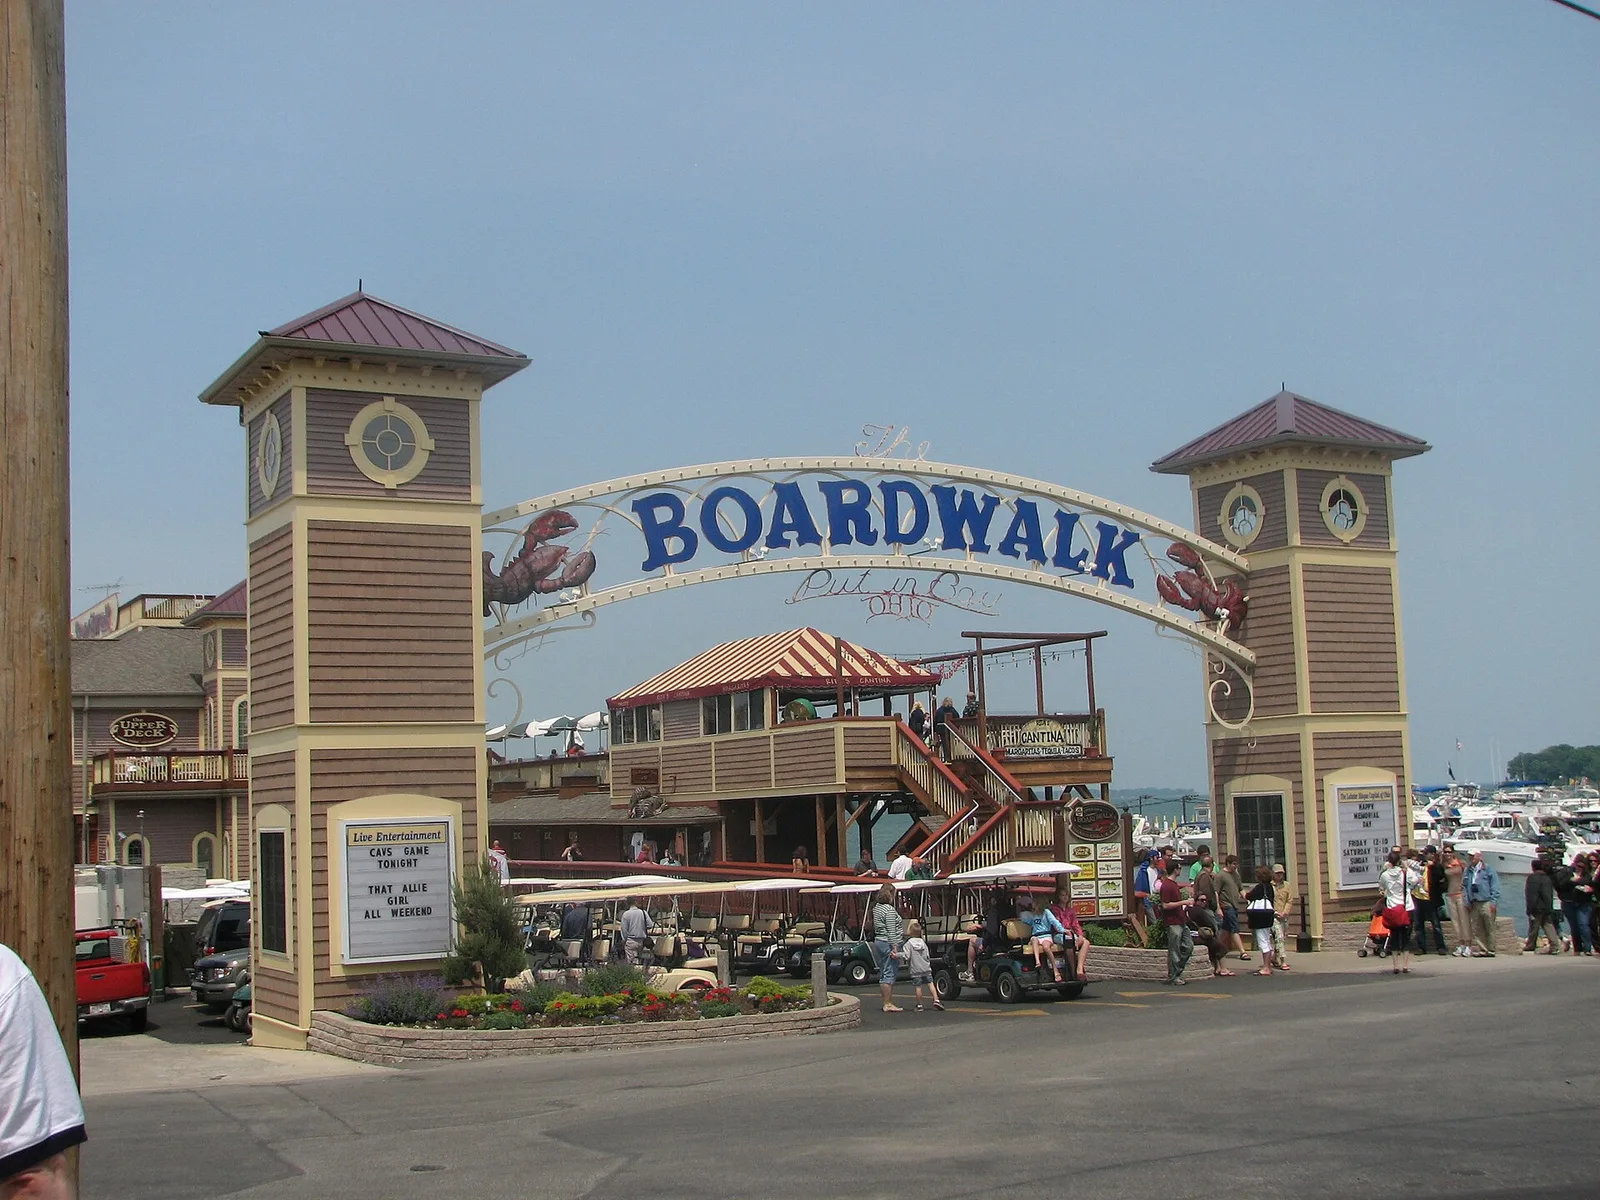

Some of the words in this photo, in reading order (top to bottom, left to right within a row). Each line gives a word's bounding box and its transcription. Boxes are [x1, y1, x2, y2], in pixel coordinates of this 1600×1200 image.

[854, 423, 930, 462] The
[631, 480, 1141, 588] BOARDWALK
[787, 568, 872, 603] Put
[889, 577, 918, 597] in
[927, 571, 1003, 609] Bay
[862, 594, 938, 622] OHIO
[120, 720, 167, 729] UPPER
[123, 729, 165, 737] DECK
[1021, 731, 1064, 743] CANTINA
[353, 832, 373, 843] Live
[376, 830, 441, 842] Entertainment
[1348, 839, 1367, 847] FRIDAY
[369, 847, 393, 857] CAVS
[404, 846, 429, 856] GAME
[1343, 848, 1370, 856] SATURDAY
[378, 858, 418, 869] TONIGHT
[1350, 857, 1368, 865] SUNDAY
[1348, 865, 1369, 873] MONDAY
[368, 884, 393, 894] THAT
[402, 883, 428, 893] ALLIE
[387, 896, 409, 906] GIRL
[364, 909, 381, 919] ALL
[391, 906, 432, 918] WEEKEND
